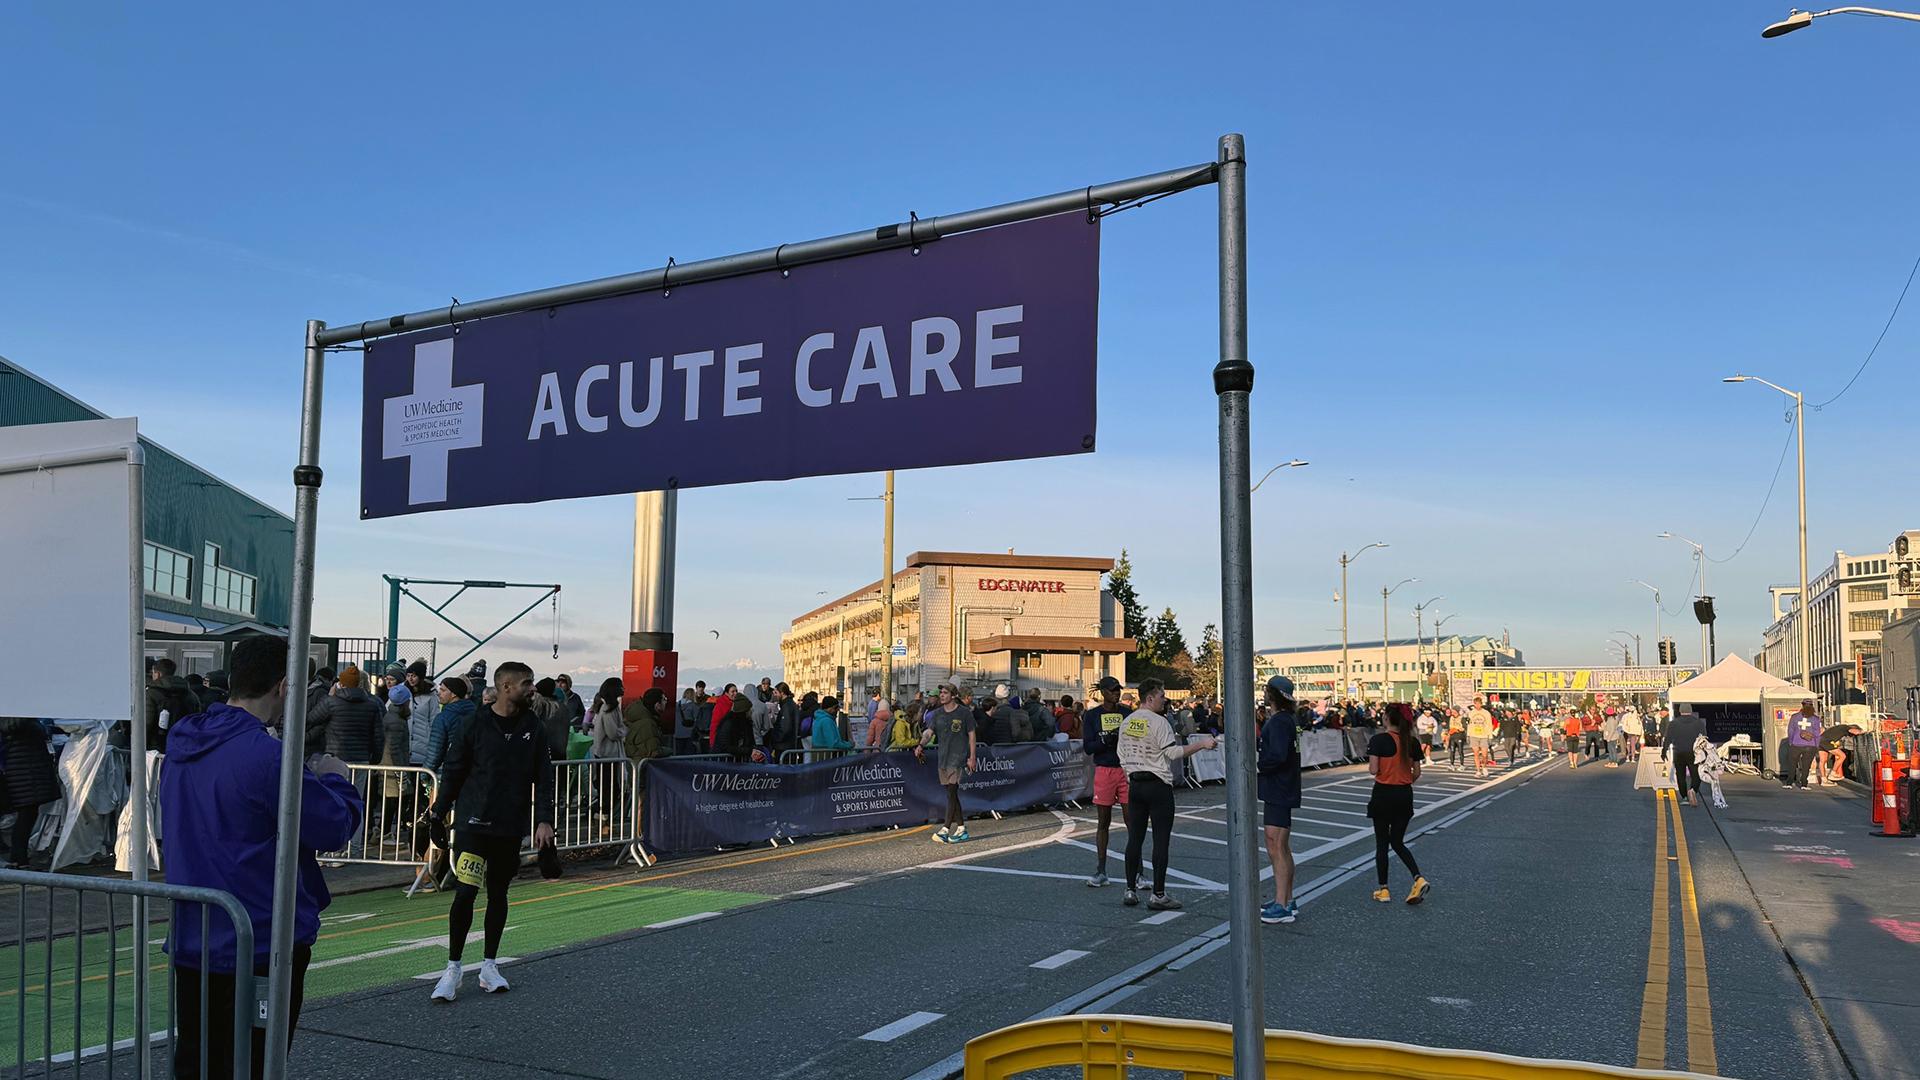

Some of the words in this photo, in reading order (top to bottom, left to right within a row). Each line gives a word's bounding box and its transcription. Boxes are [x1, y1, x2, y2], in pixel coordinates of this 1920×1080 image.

[527, 342, 764, 441] ACUTE
[794, 304, 1024, 408] CARE
[404, 402, 421, 418] UW
[421, 398, 463, 415] Medicine
[403, 420, 437, 433] ORTHOPEDIC
[438, 418, 462, 428] HEALTH
[410, 431, 430, 442] SPORTS
[430, 427, 460, 438] MEDICINE
[978, 578, 1067, 594] EDGEWATER
[652, 665, 666, 678] 66
[1481, 671, 1565, 689] FINISH
[975, 755, 1015, 772] Medicine
[832, 766, 854, 783] UW
[853, 763, 902, 781] Medicine
[691, 773, 721, 792] UW
[720, 773, 781, 791] Medicine
[831, 789, 876, 802] ORTHOPEDIC
[877, 786, 904, 797] HEALTH
[695, 804, 700, 812] A
[700, 804, 718, 814] higher
[719, 802, 738, 812] degree
[738, 801, 745, 809] of
[745, 800, 775, 809] healthcare
[835, 804, 841, 813] &
[842, 801, 869, 813] SPORTS
[869, 798, 903, 809] MEDICINE
